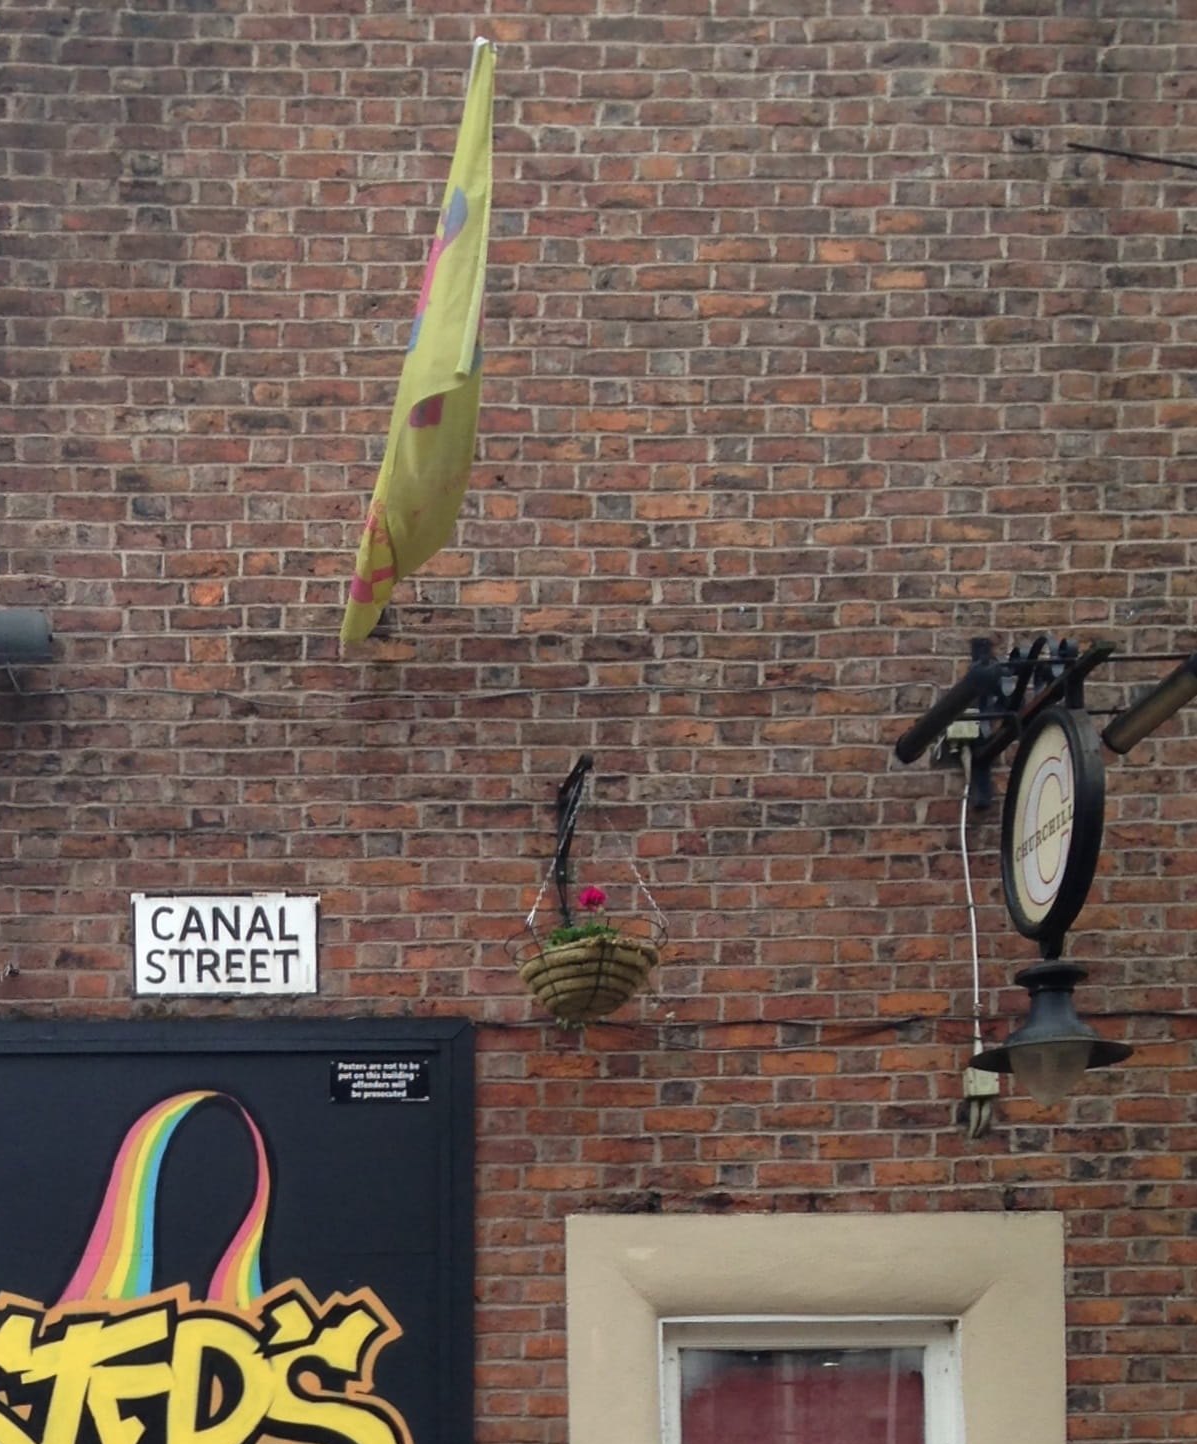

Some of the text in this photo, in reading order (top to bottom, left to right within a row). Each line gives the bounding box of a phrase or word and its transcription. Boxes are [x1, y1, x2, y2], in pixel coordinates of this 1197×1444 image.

[151, 905, 299, 942] CANAL
[145, 948, 300, 985] STREET
[338, 1062, 367, 1070] Posters
[398, 1062, 408, 1070] to
[409, 1062, 420, 1070] be
[338, 1072, 352, 1081] put
[366, 1071, 381, 1079] this
[382, 1071, 414, 1081] building
[352, 1080, 406, 1088] offenders will
[351, 1089, 407, 1099] be prosecuted
